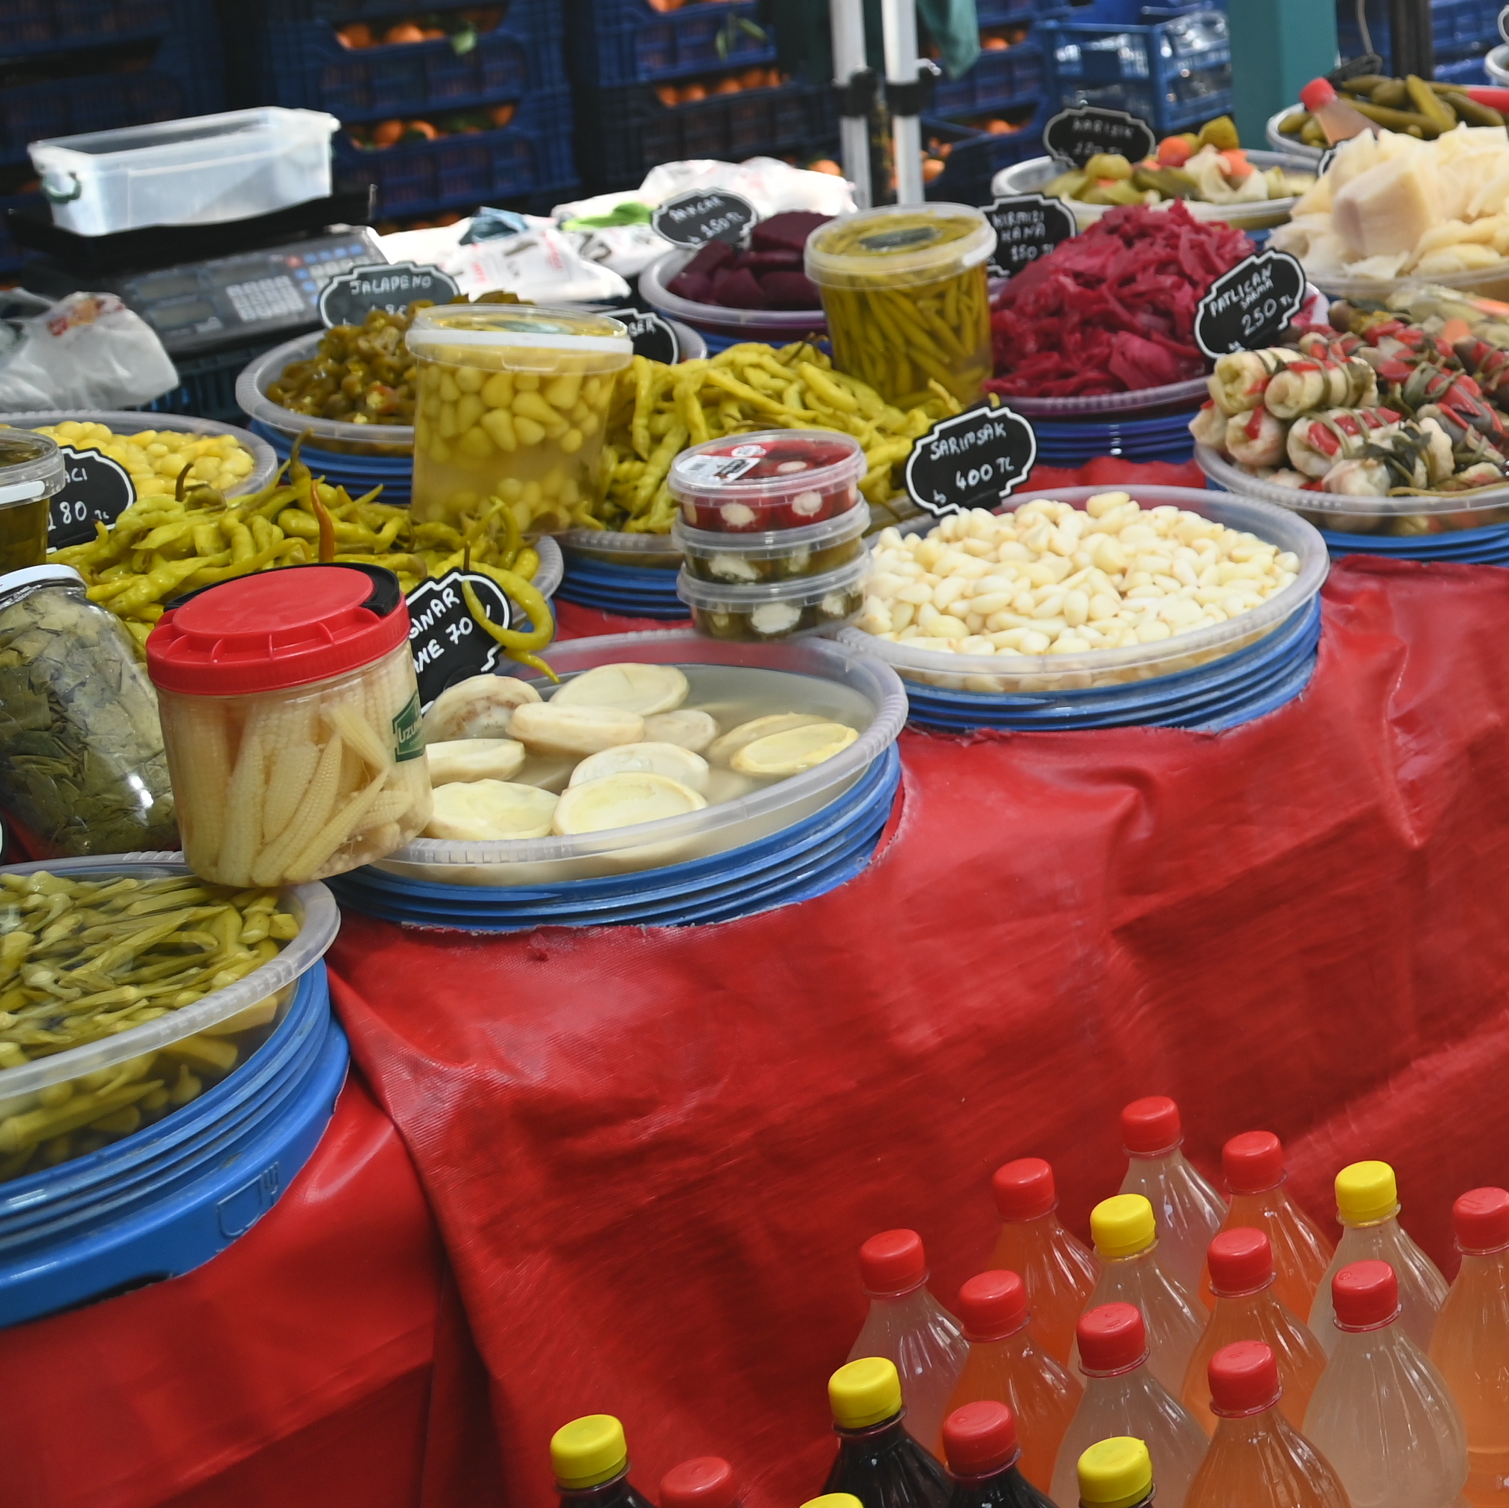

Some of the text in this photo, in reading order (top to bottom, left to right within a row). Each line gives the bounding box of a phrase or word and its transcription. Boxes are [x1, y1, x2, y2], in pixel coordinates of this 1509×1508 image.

[350, 275, 433, 295] JALAPENO
[1209, 263, 1272, 318] PATLICAN
[1241, 298, 1277, 337] 250
[930, 422, 1007, 461] SARIMSAK
[956, 456, 1015, 491] 400 TL
[445, 617, 473, 645] 70
